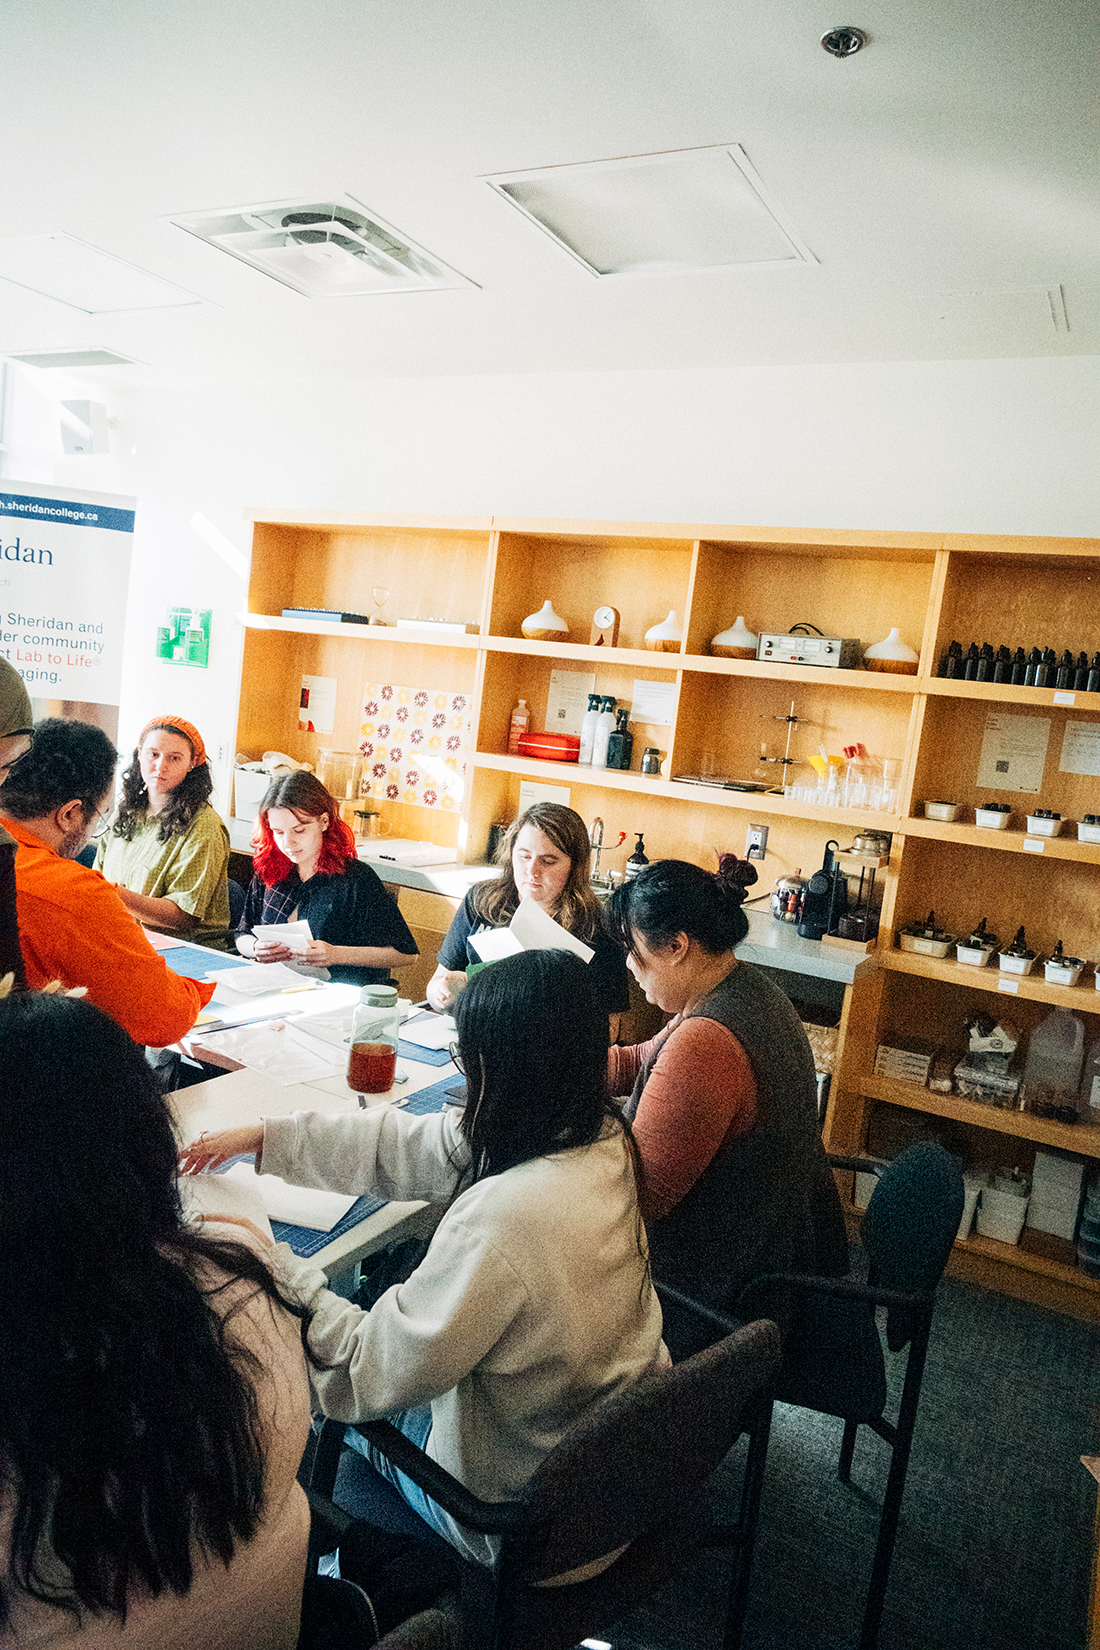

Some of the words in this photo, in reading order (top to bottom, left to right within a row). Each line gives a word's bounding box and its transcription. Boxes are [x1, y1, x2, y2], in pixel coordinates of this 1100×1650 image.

[7, 612, 74, 631] Sheridan
[78, 622, 104, 635] and
[23, 634, 105, 655] community
[16, 648, 43, 663] Lab
[47, 652, 62, 665] to
